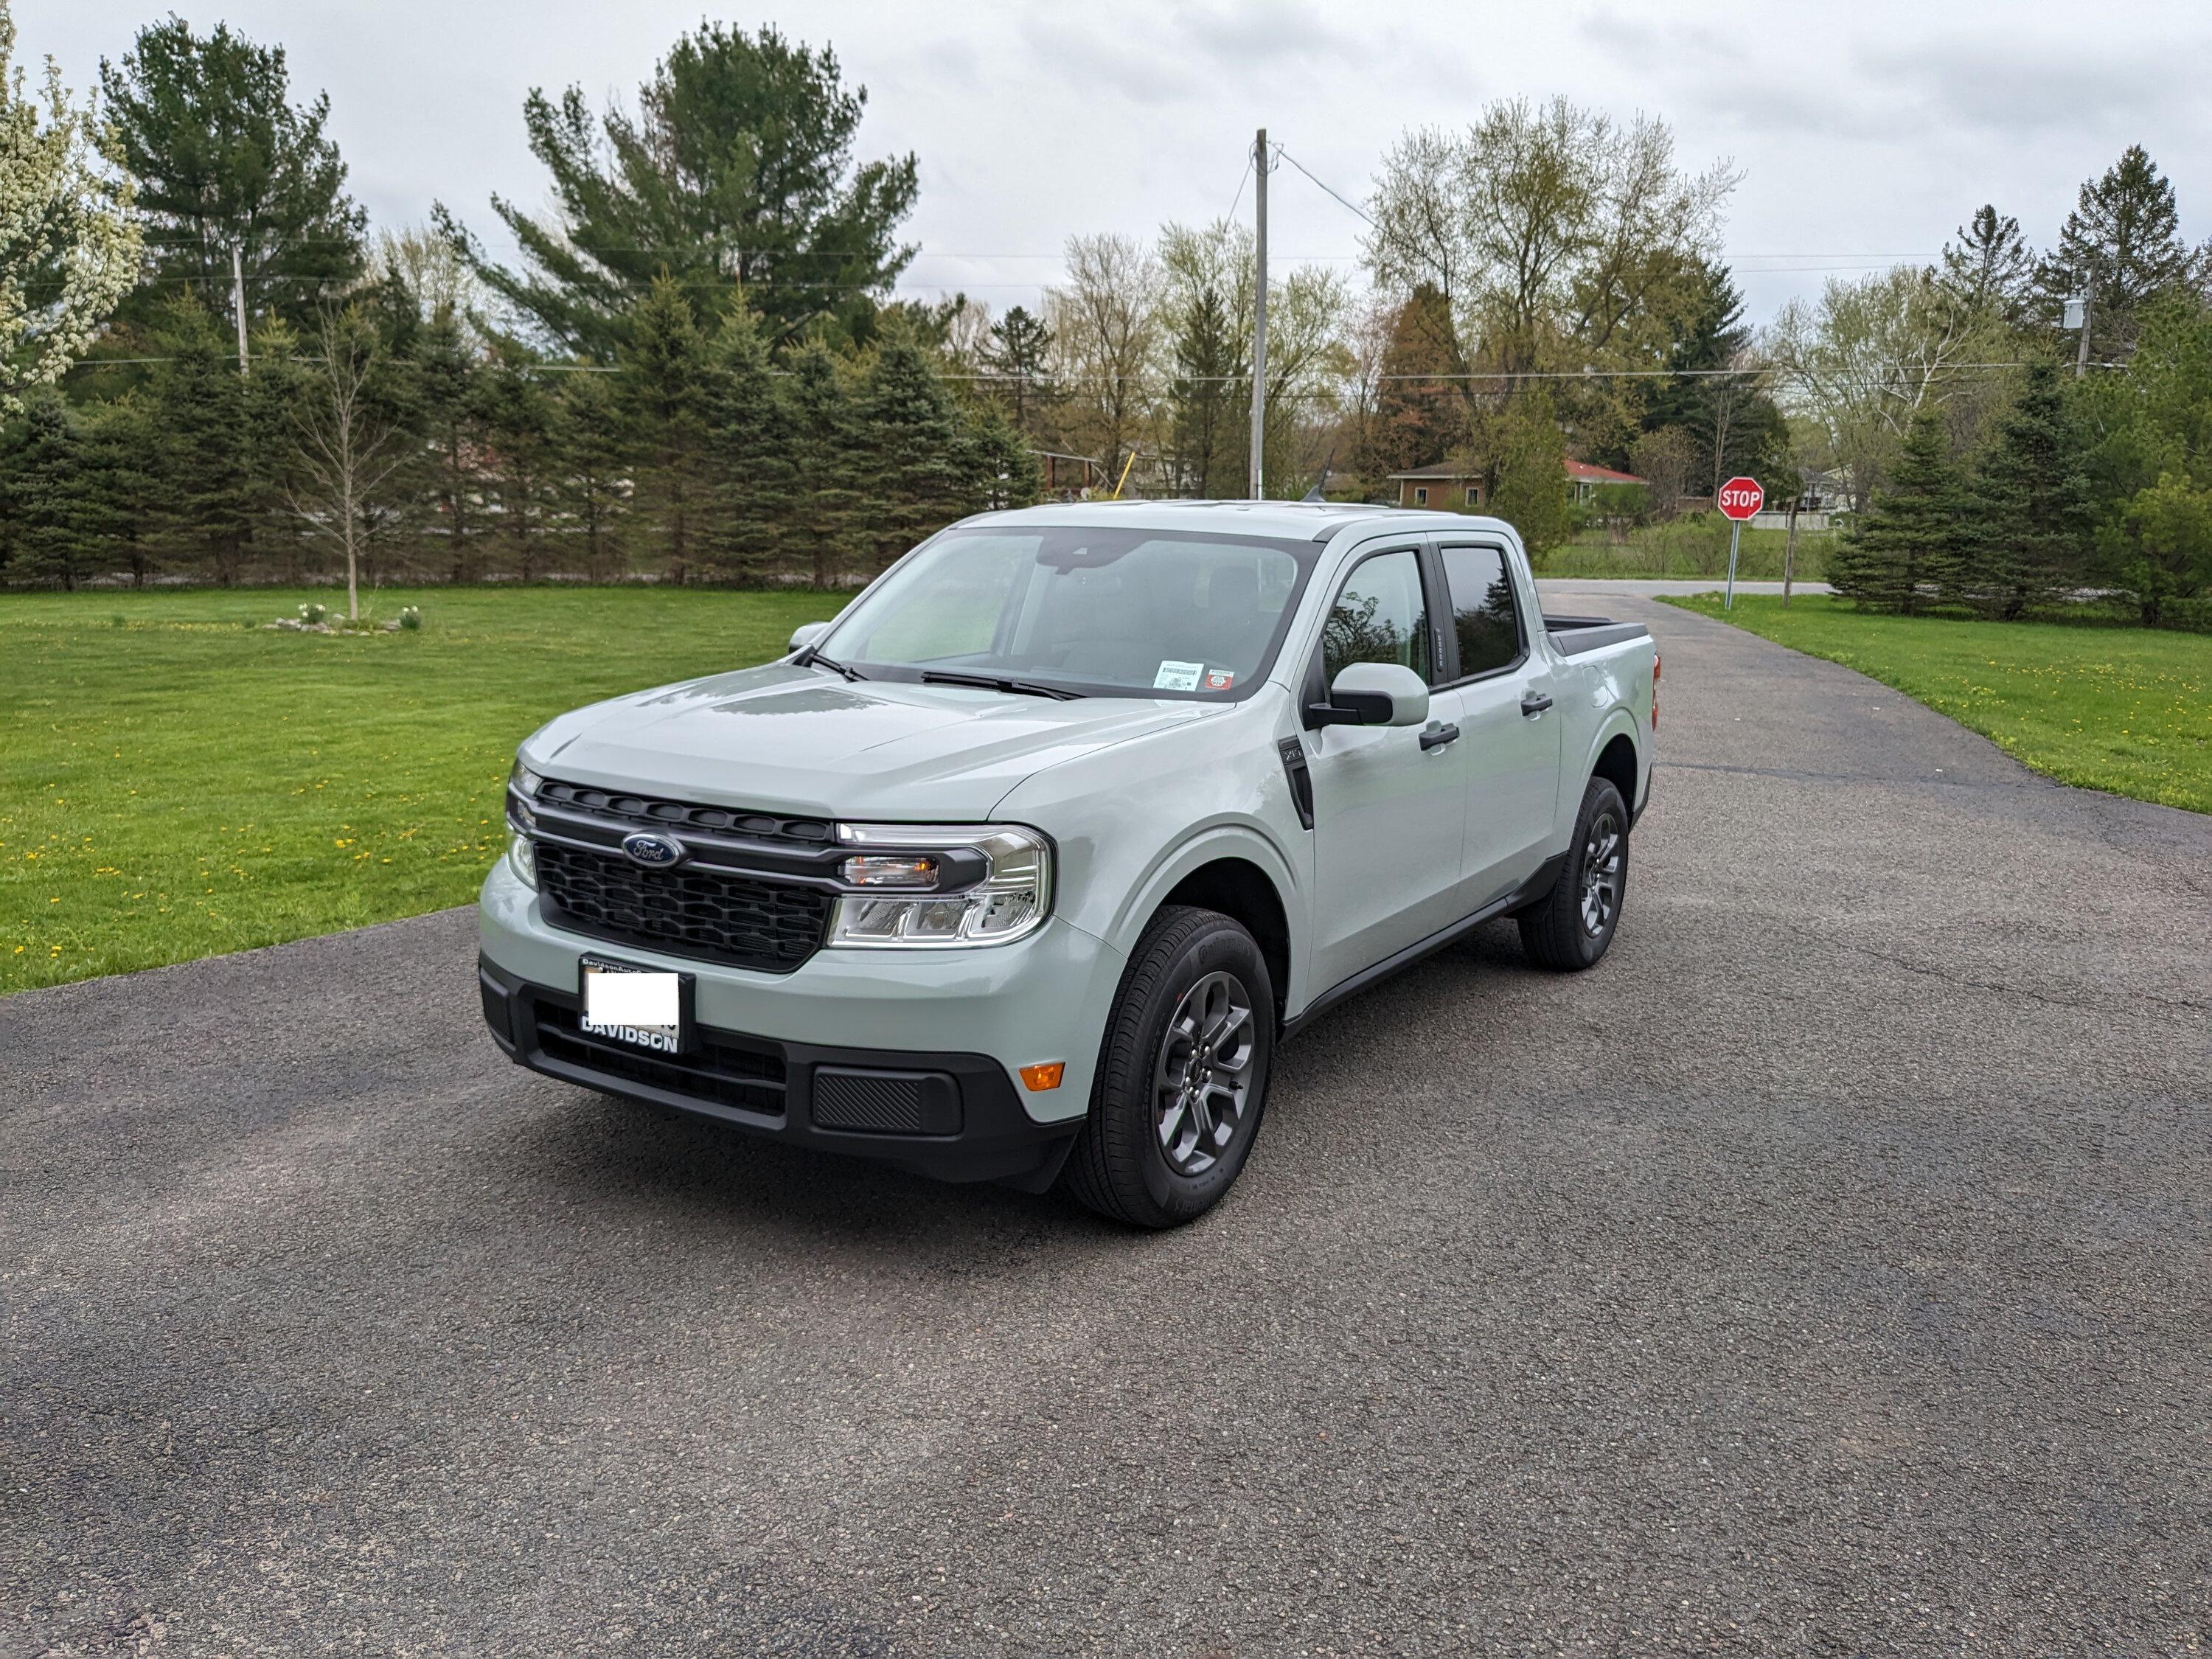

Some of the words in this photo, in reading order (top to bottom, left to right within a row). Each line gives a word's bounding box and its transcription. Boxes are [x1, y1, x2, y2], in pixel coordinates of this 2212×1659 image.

[1722, 490, 1760, 507] STOP
[634, 840, 664, 860] Ford
[582, 1015, 678, 1054] DAVIDSON
